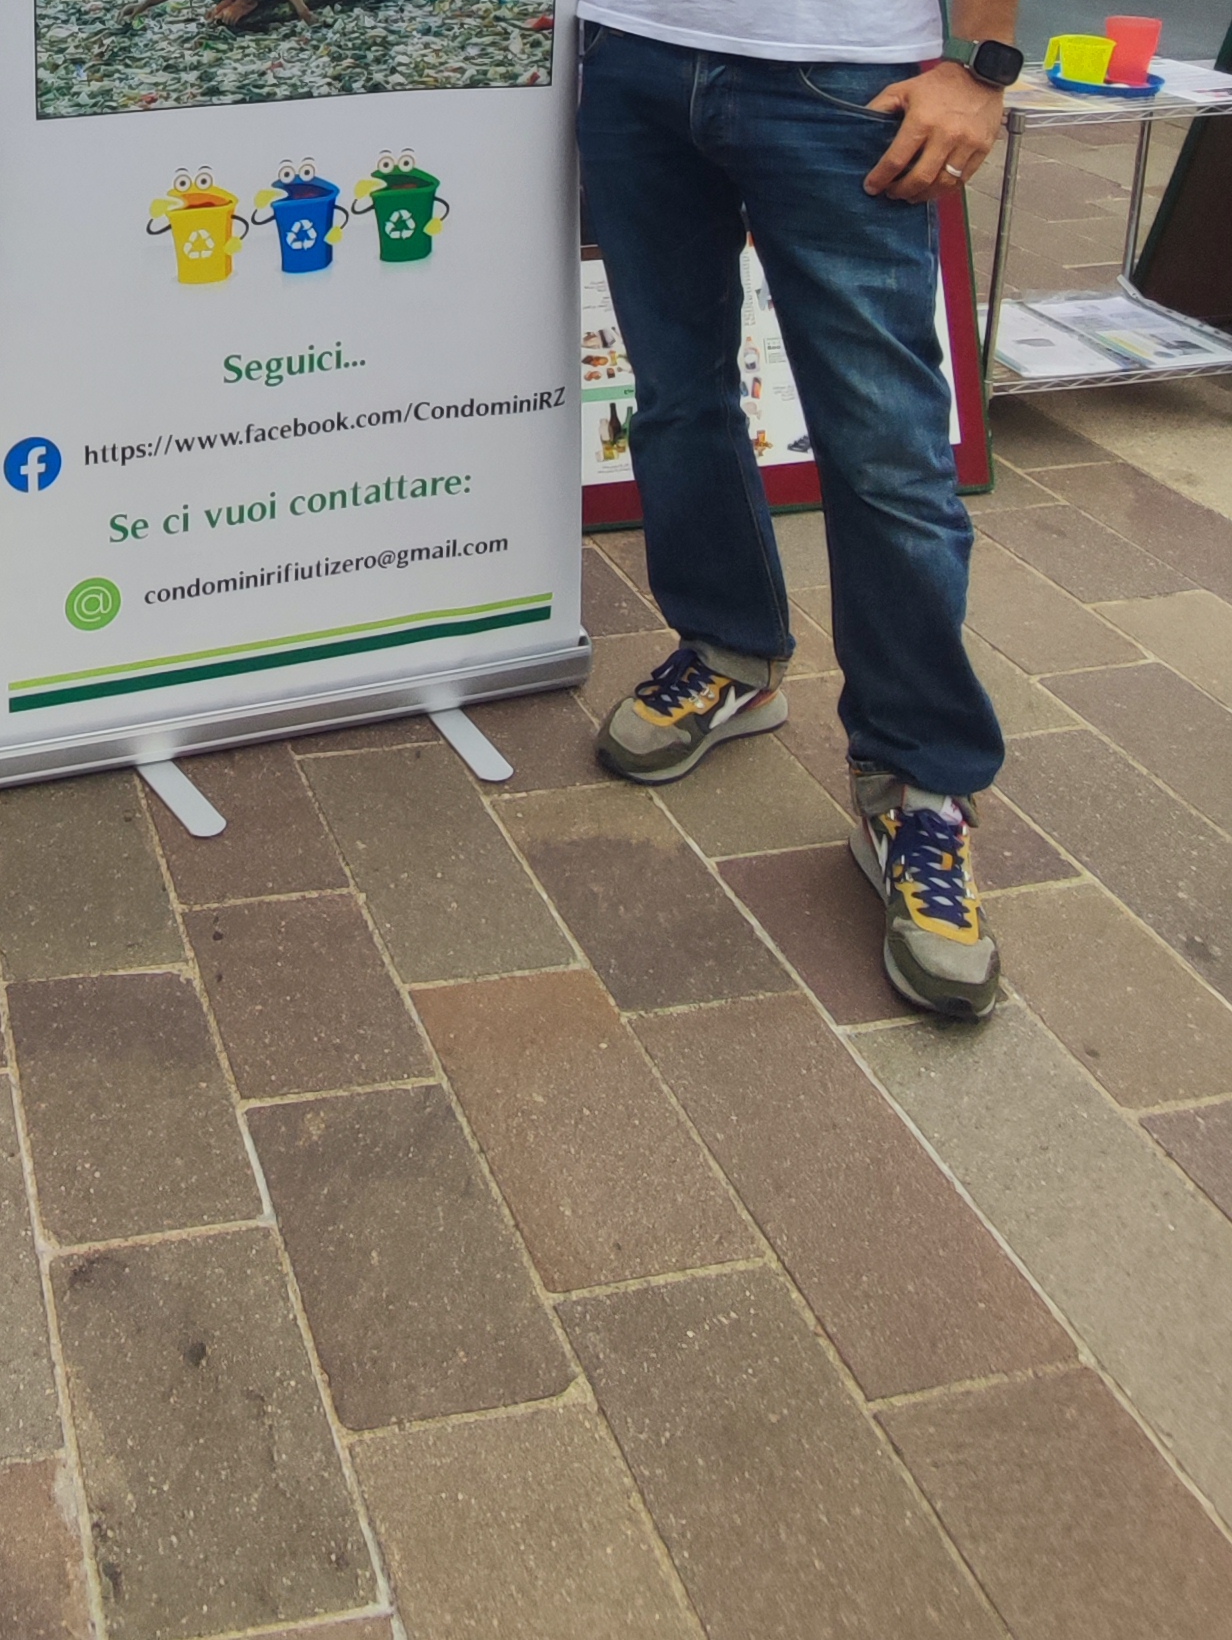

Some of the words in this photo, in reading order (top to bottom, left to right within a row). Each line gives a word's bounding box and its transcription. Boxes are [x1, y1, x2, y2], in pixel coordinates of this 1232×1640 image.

[224, 342, 365, 387] Seguici...
[85, 386, 565, 466] https://www.facebook.com/CondominiRZ
[110, 514, 149, 542] Se
[163, 505, 188, 534] ci
[204, 492, 275, 528] vuoi
[290, 475, 471, 515] contattare:
[144, 538, 508, 604] condominirifiutizero@gmail.com
